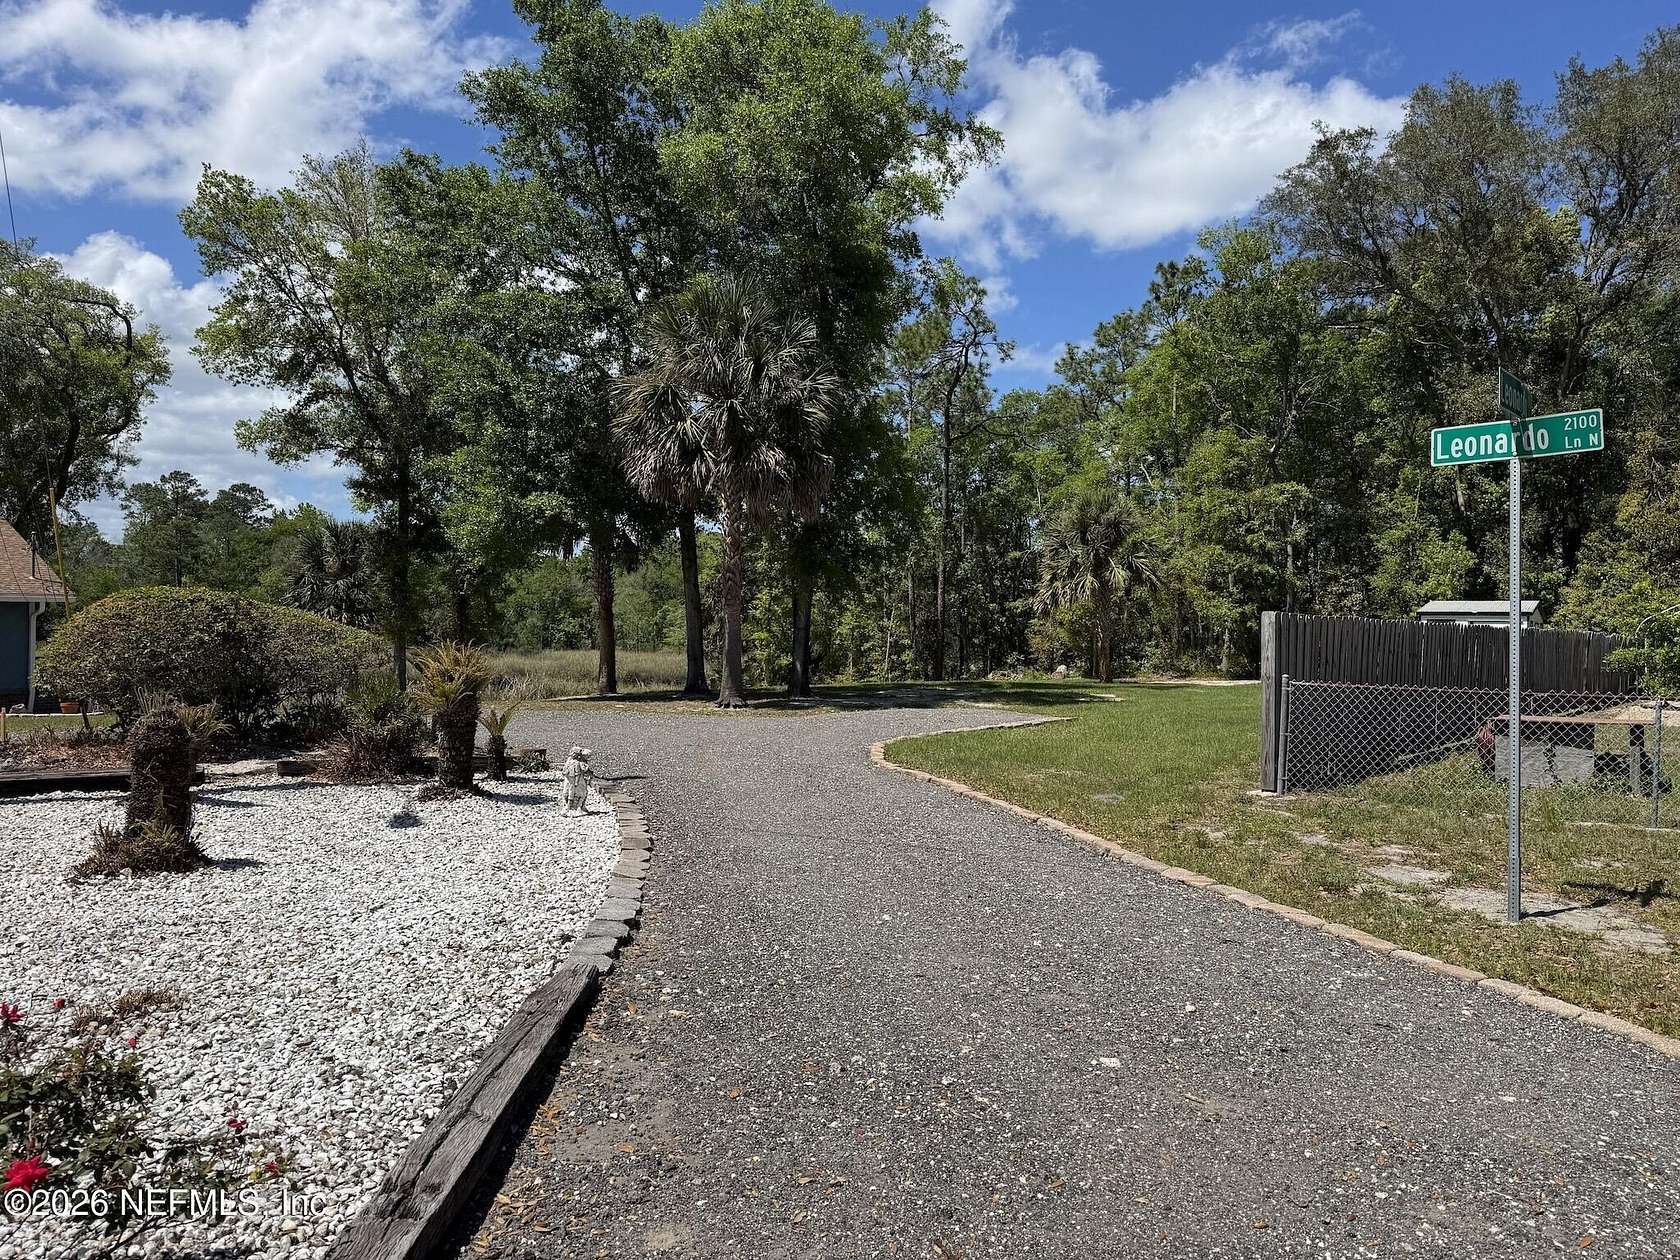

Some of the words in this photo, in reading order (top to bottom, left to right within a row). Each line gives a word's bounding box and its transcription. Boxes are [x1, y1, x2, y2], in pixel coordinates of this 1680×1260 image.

[1564, 415, 1597, 431] 2100
[1436, 423, 1549, 460] Leonardo
[1565, 436, 1582, 449] Ln
[1589, 433, 1599, 446] N
